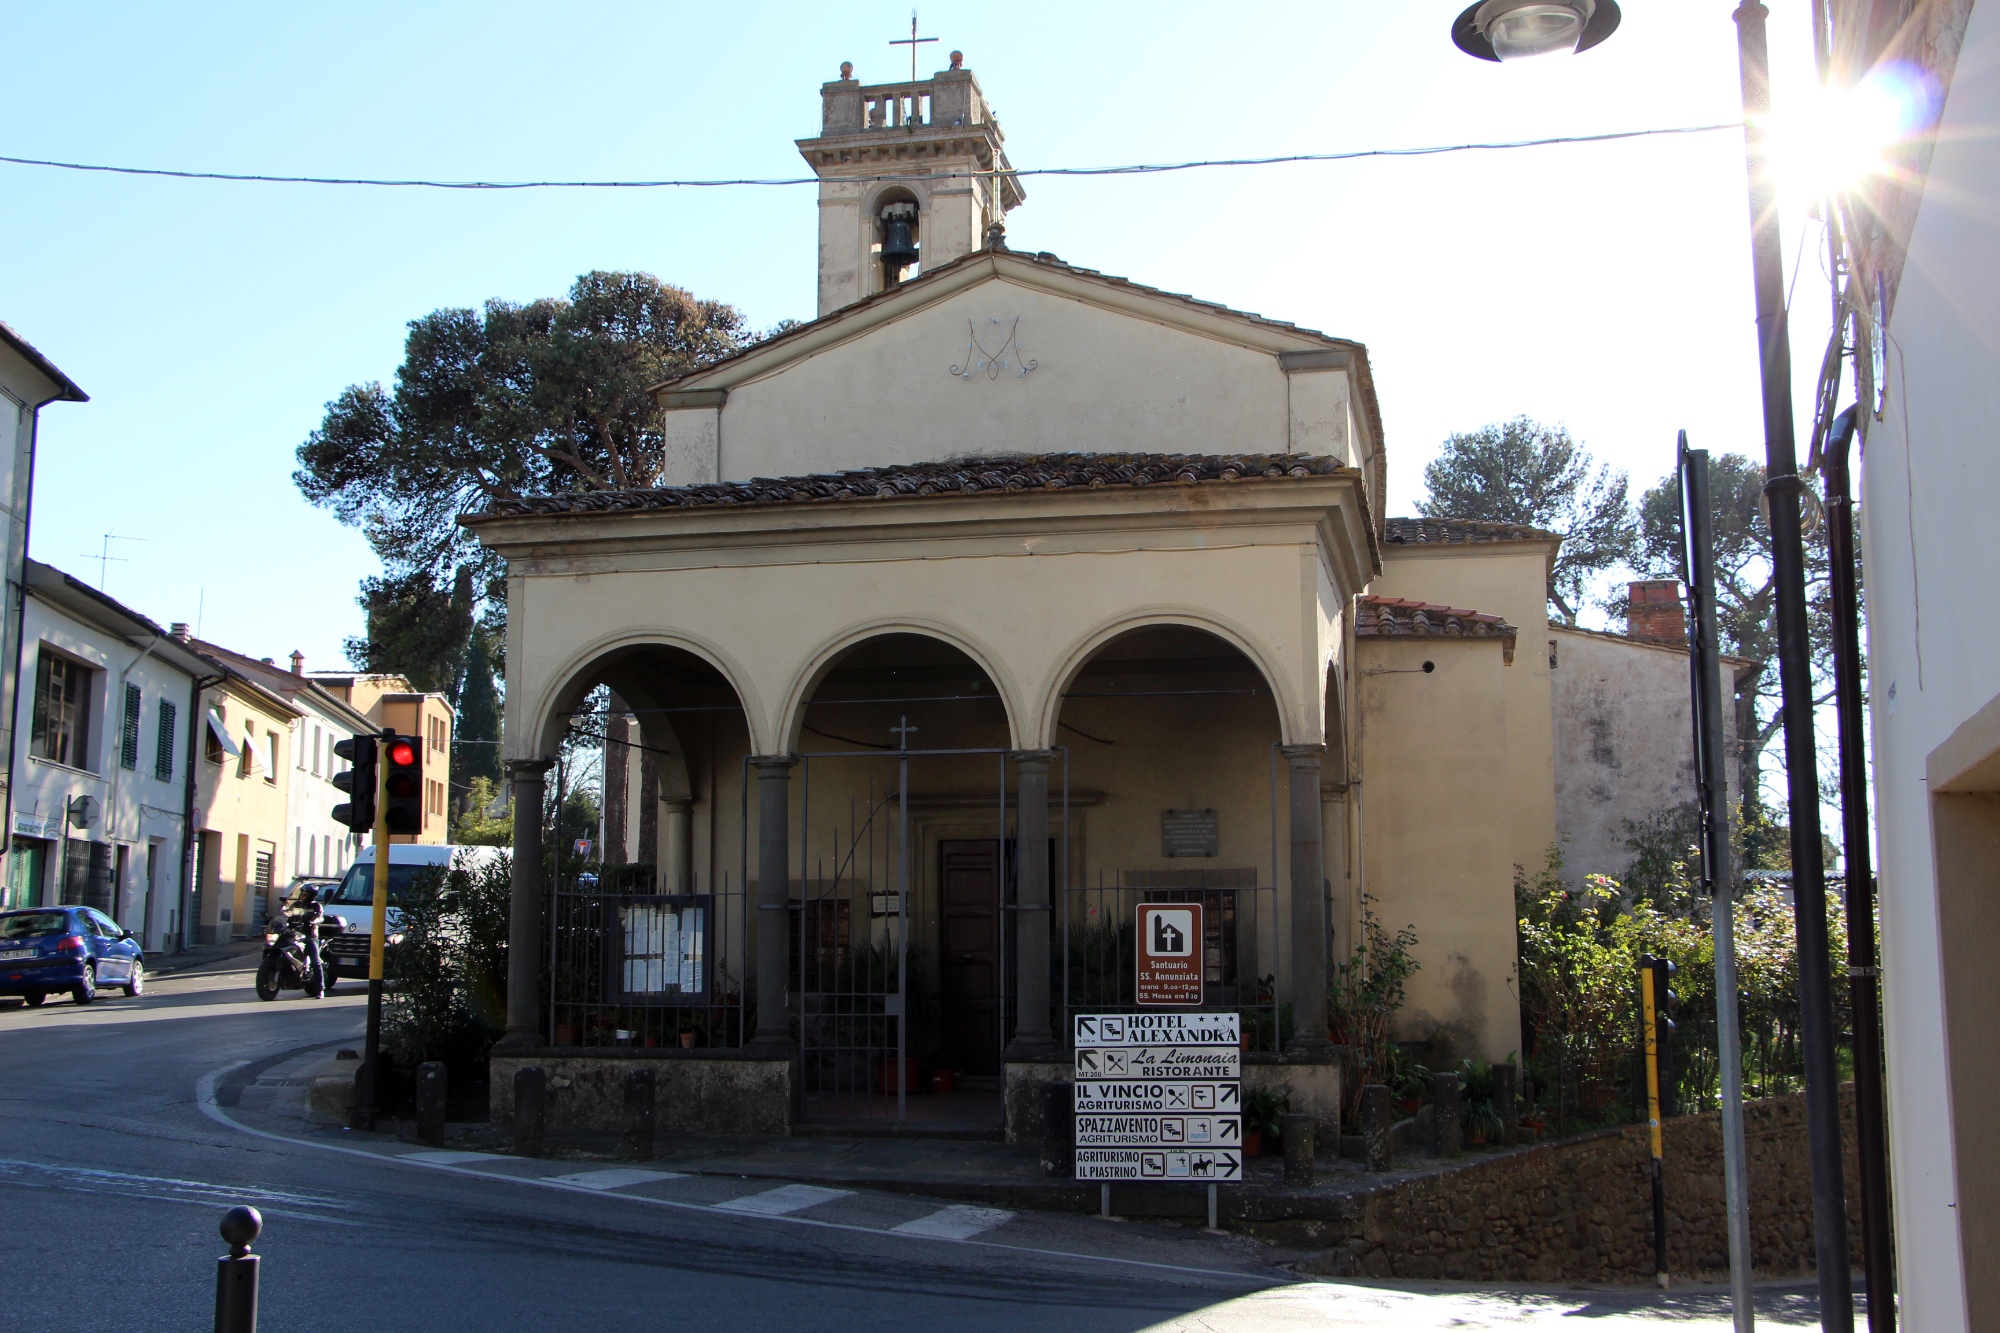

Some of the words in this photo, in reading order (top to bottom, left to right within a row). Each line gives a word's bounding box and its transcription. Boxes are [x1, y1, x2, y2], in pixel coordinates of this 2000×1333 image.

[1151, 960, 1188, 969] Santuario
[1140, 972, 1152, 981] SS.
[1155, 972, 1199, 981] Annunziata
[1128, 1016, 1187, 1029] HOTEL
[1128, 1029, 1238, 1043] ALEXANDRA
[1131, 1048, 1157, 1064] La
[1160, 1048, 1239, 1064] Limonaia
[1142, 1066, 1230, 1077] RISTORANTE
[1077, 1085, 1091, 1098] IL
[1098, 1085, 1164, 1099] VINCIO
[1077, 1100, 1163, 1111] AGRITURISMO
[1078, 1117, 1158, 1133] SPAZZAVENTO
[1079, 1134, 1158, 1144] AGRITURISMO
[1077, 1151, 1140, 1163] AGRITURISMO
[1079, 1166, 1088, 1177] IL
[1090, 1166, 1137, 1178] PIASTRINO
